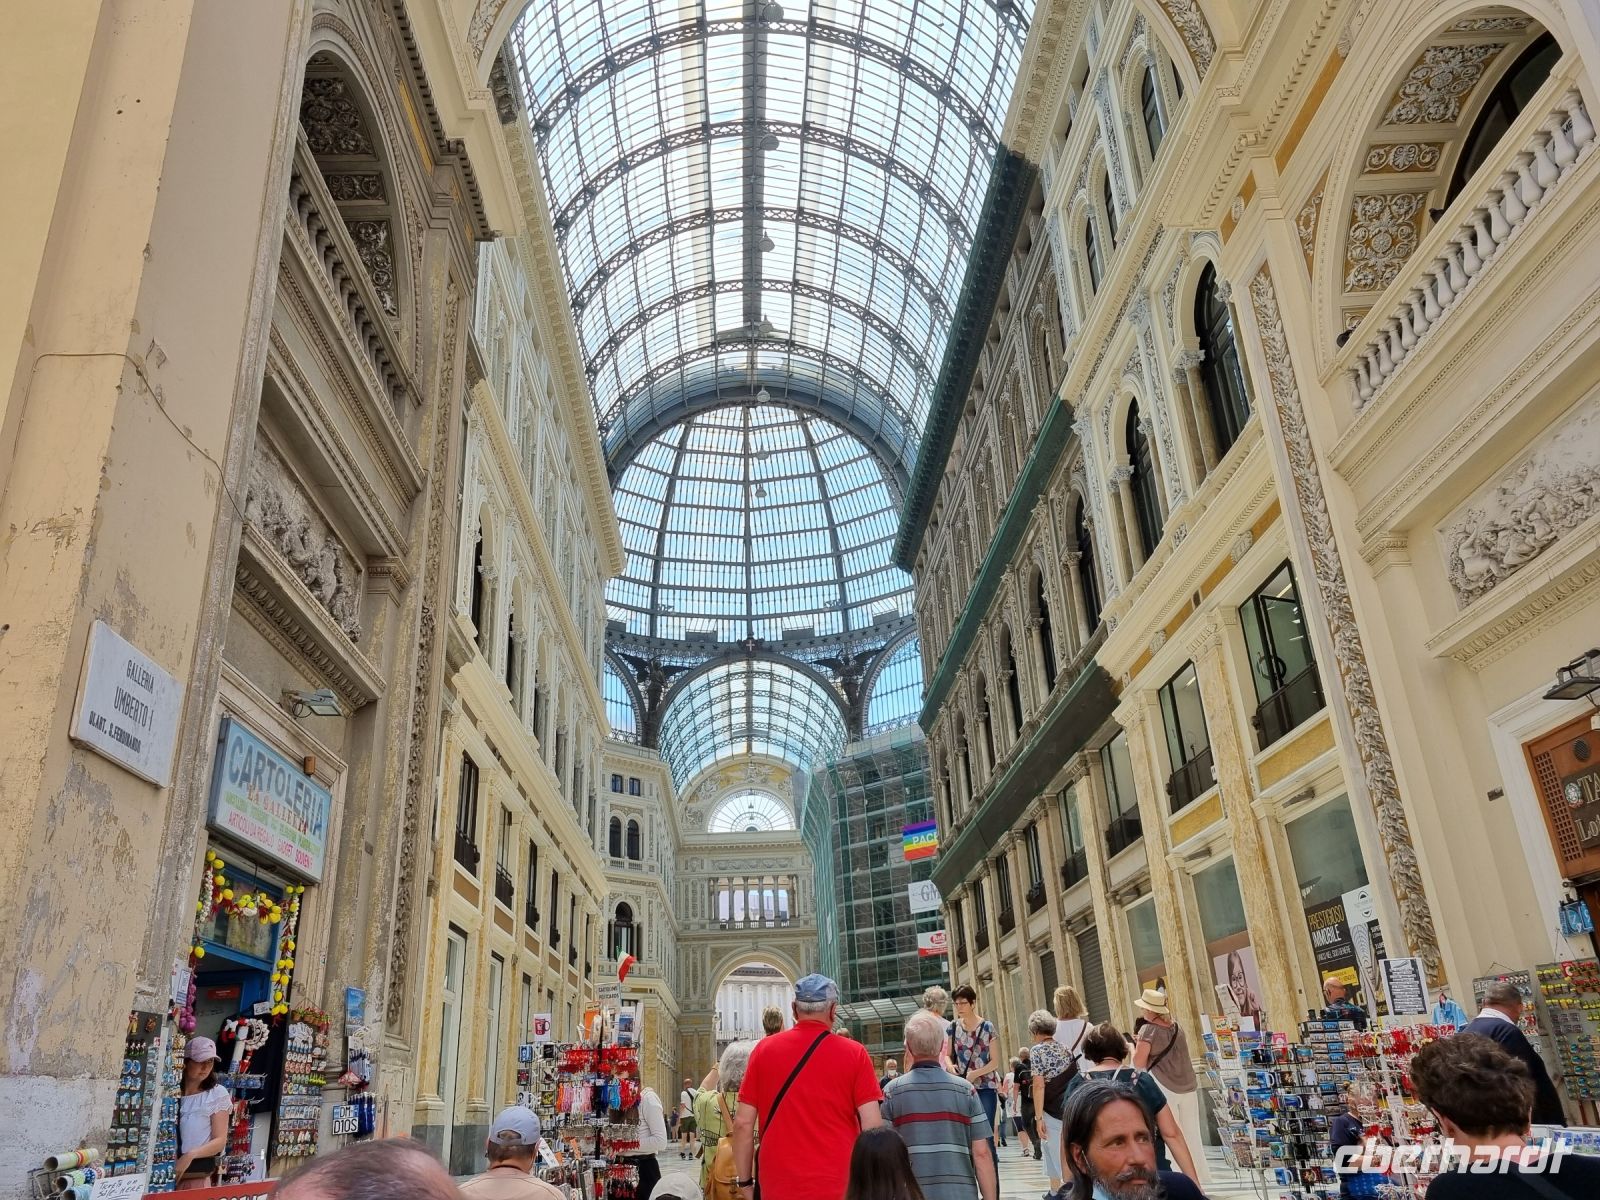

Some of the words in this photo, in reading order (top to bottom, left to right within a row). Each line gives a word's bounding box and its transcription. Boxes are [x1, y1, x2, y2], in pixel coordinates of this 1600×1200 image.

[126, 659, 155, 694] GALLERIA
[113, 686, 149, 728] UMBERTO
[228, 735, 323, 841] CARTOLERIA
[1307, 904, 1345, 932] PRESTIGIOSO
[1311, 923, 1342, 949] IMMOBILE
